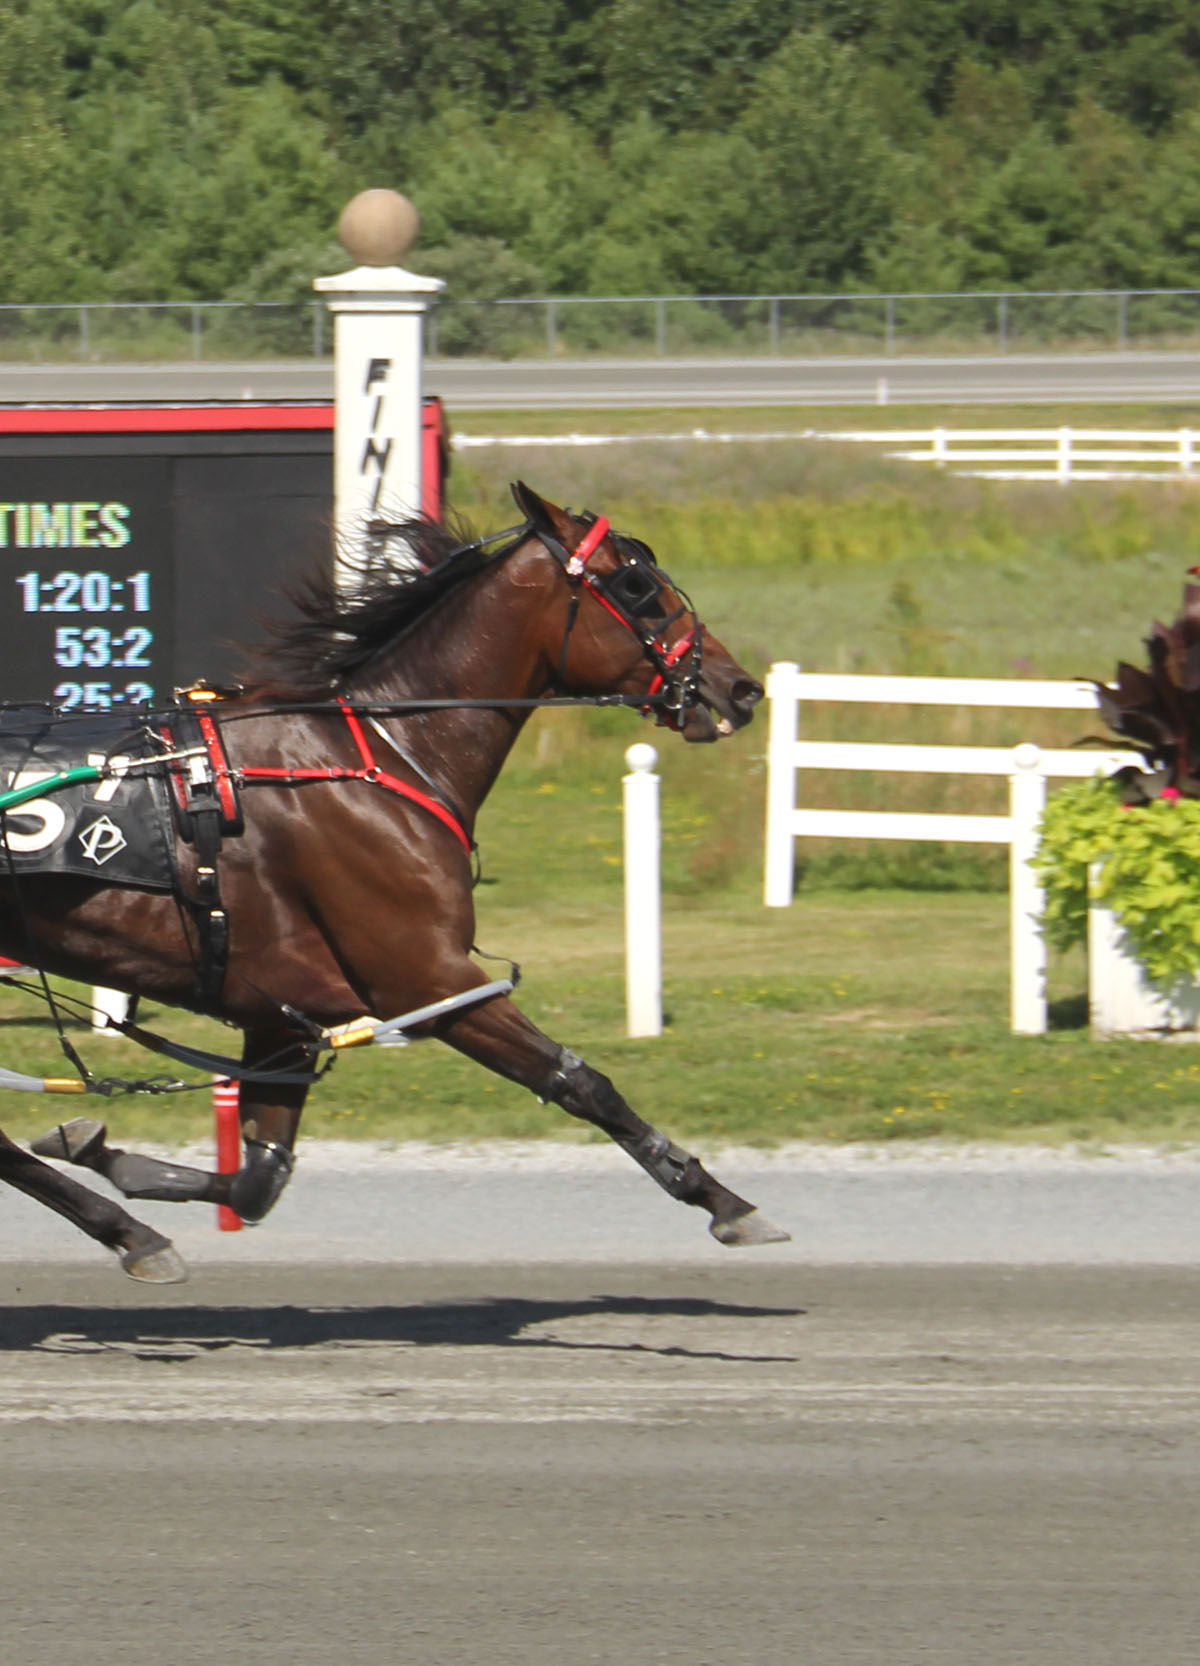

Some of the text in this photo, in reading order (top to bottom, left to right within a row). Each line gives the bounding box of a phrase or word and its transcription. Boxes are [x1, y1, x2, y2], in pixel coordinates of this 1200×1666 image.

[15, 571, 150, 613] 1:20:1
[54, 626, 153, 668] 53:2
[1, 770, 66, 853] 5
